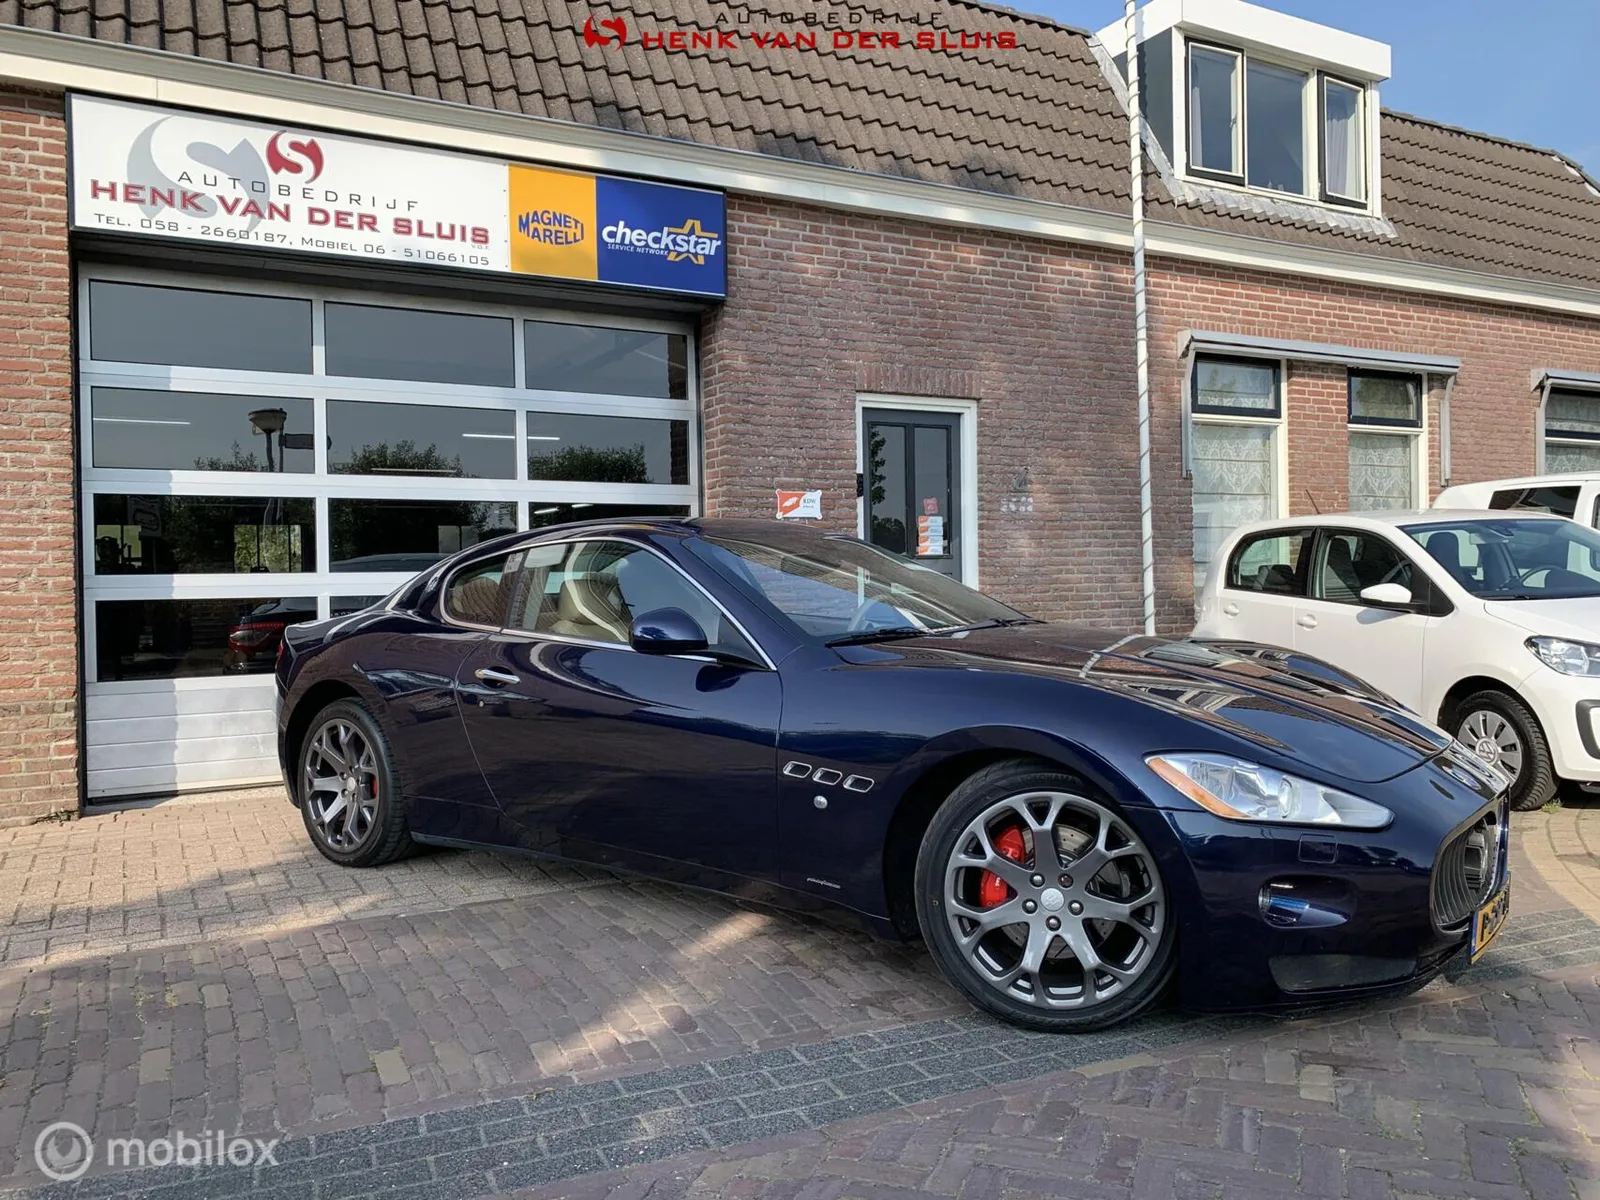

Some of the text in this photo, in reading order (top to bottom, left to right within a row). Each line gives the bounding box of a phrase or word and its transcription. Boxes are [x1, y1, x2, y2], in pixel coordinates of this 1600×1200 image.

[178, 171, 418, 211] AUTOBEDRIJF
[90, 178, 490, 245] HENK VAN DER SLUIS
[518, 209, 584, 236] MAGNETI
[140, 218, 179, 232] 058
[201, 225, 293, 246] 2660187,
[364, 243, 385, 255] 06
[404, 248, 489, 266] 51066105
[518, 218, 584, 246] MARELLI
[601, 220, 722, 256] checkstar
[607, 243, 669, 256] SERVICE NETWORK
